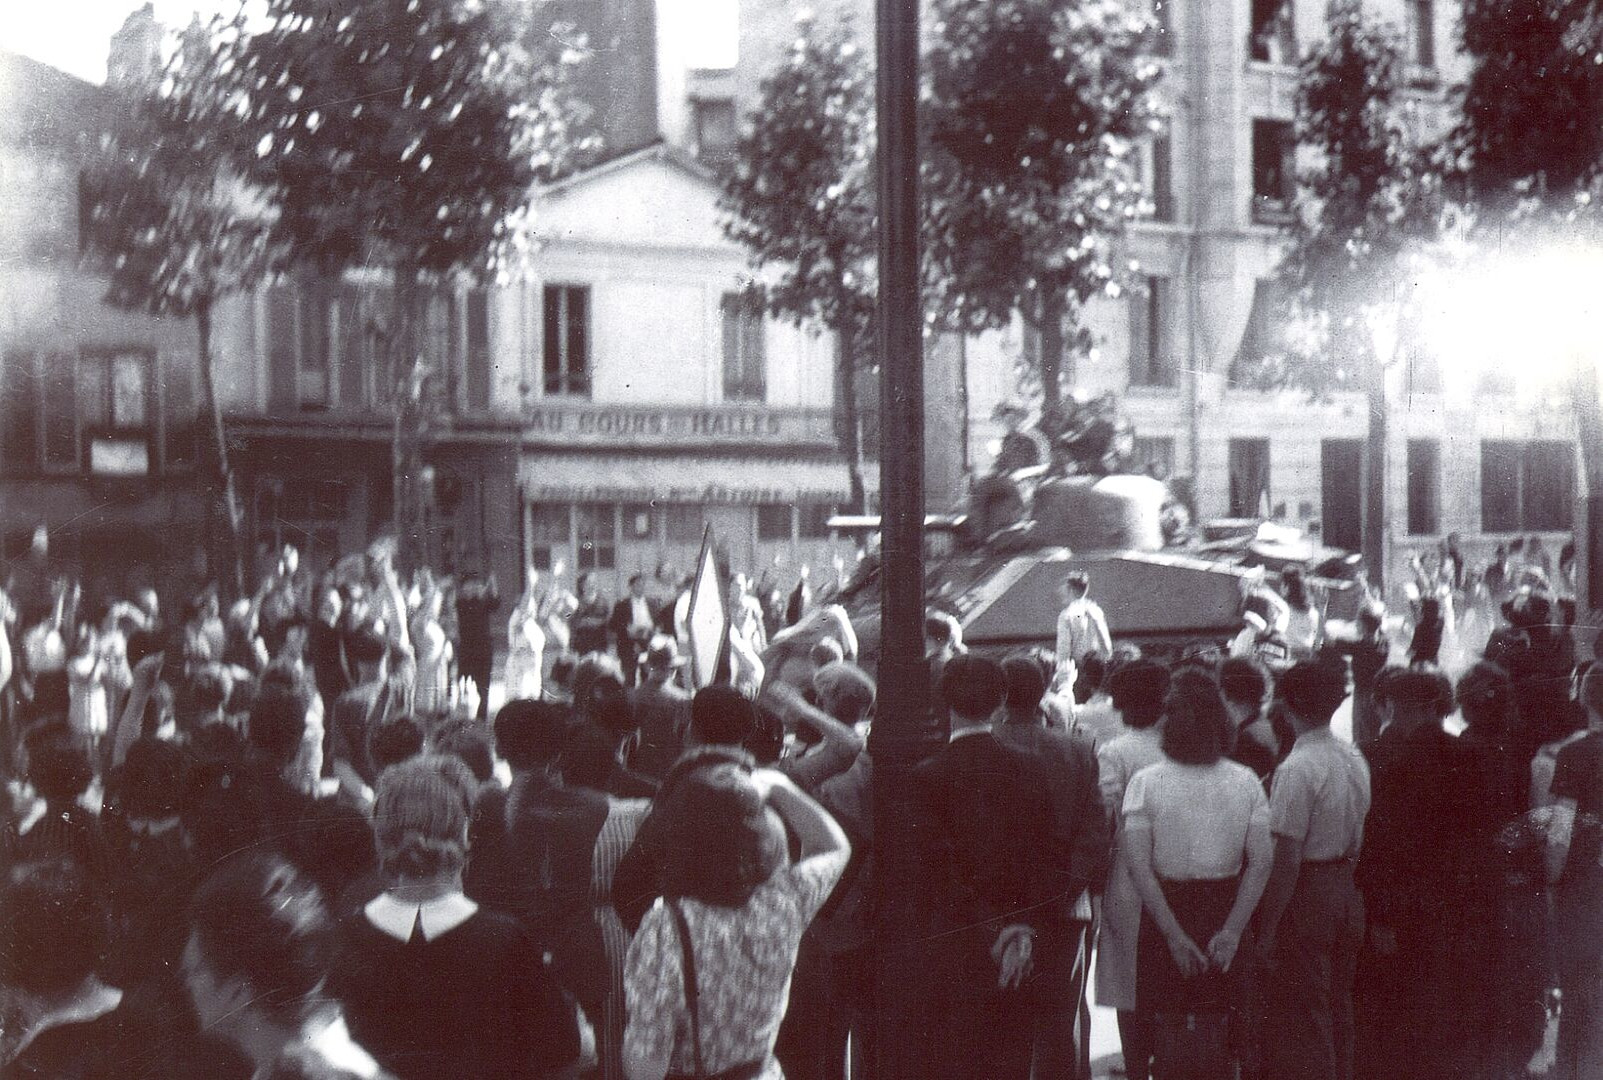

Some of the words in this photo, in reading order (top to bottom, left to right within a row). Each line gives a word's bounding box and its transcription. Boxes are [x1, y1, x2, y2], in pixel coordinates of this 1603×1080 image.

[532, 410, 563, 433] AU
[579, 411, 662, 434] COURS
[692, 411, 780, 435] HALLES
